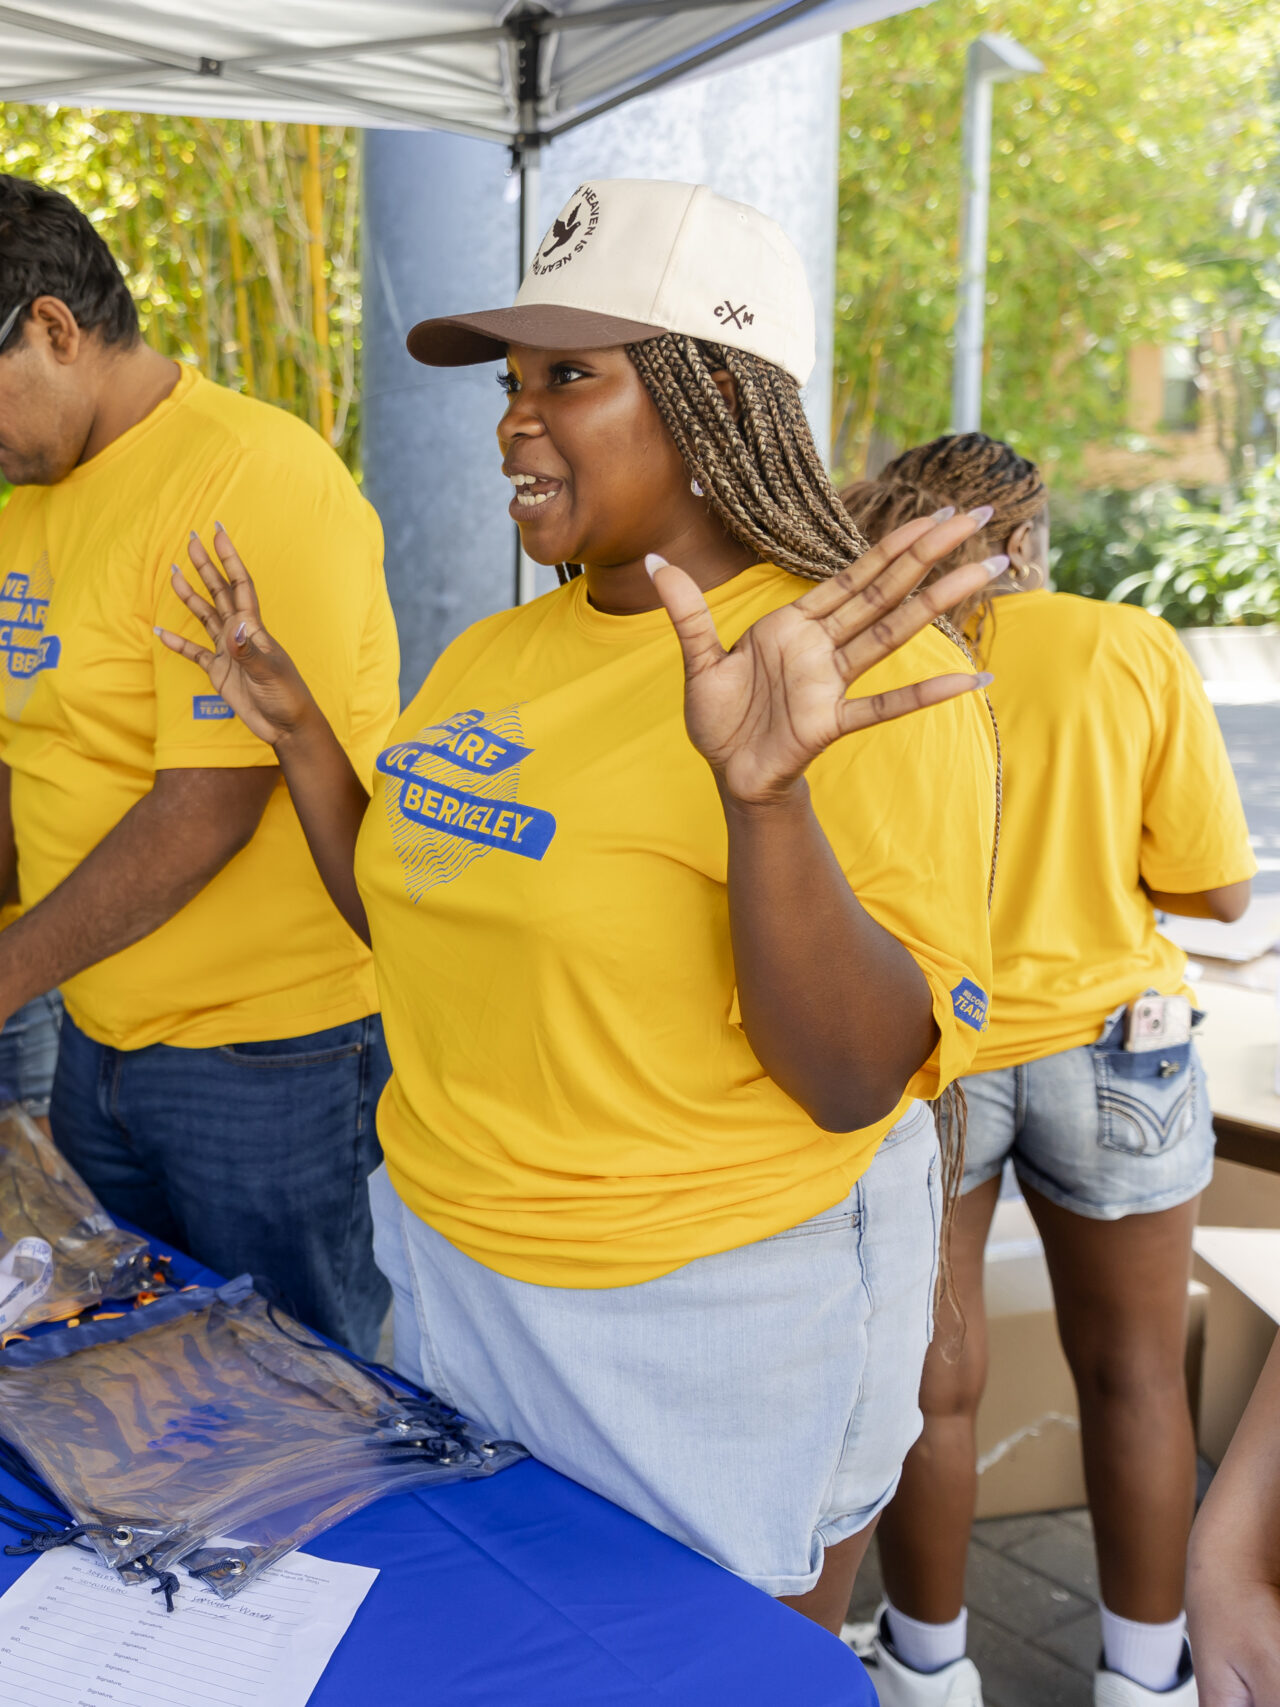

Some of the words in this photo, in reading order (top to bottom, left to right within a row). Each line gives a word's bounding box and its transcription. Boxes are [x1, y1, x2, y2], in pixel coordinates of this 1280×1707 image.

[581, 187, 600, 236] HEAVEN
[574, 239, 588, 253] IS
[540, 253, 572, 275] NEAR
[436, 732, 508, 768] ARE
[385, 746, 420, 771] UC
[403, 782, 534, 842] BERKELEY
[954, 995, 985, 1023] TEAM
[129, 1630, 156, 1640] Signature
[121, 1641, 148, 1651] Signature
[113, 1652, 139, 1662] Signature
[104, 1663, 131, 1674] Signature
[95, 1675, 122, 1686] Signature
[86, 1687, 113, 1699] Signature
